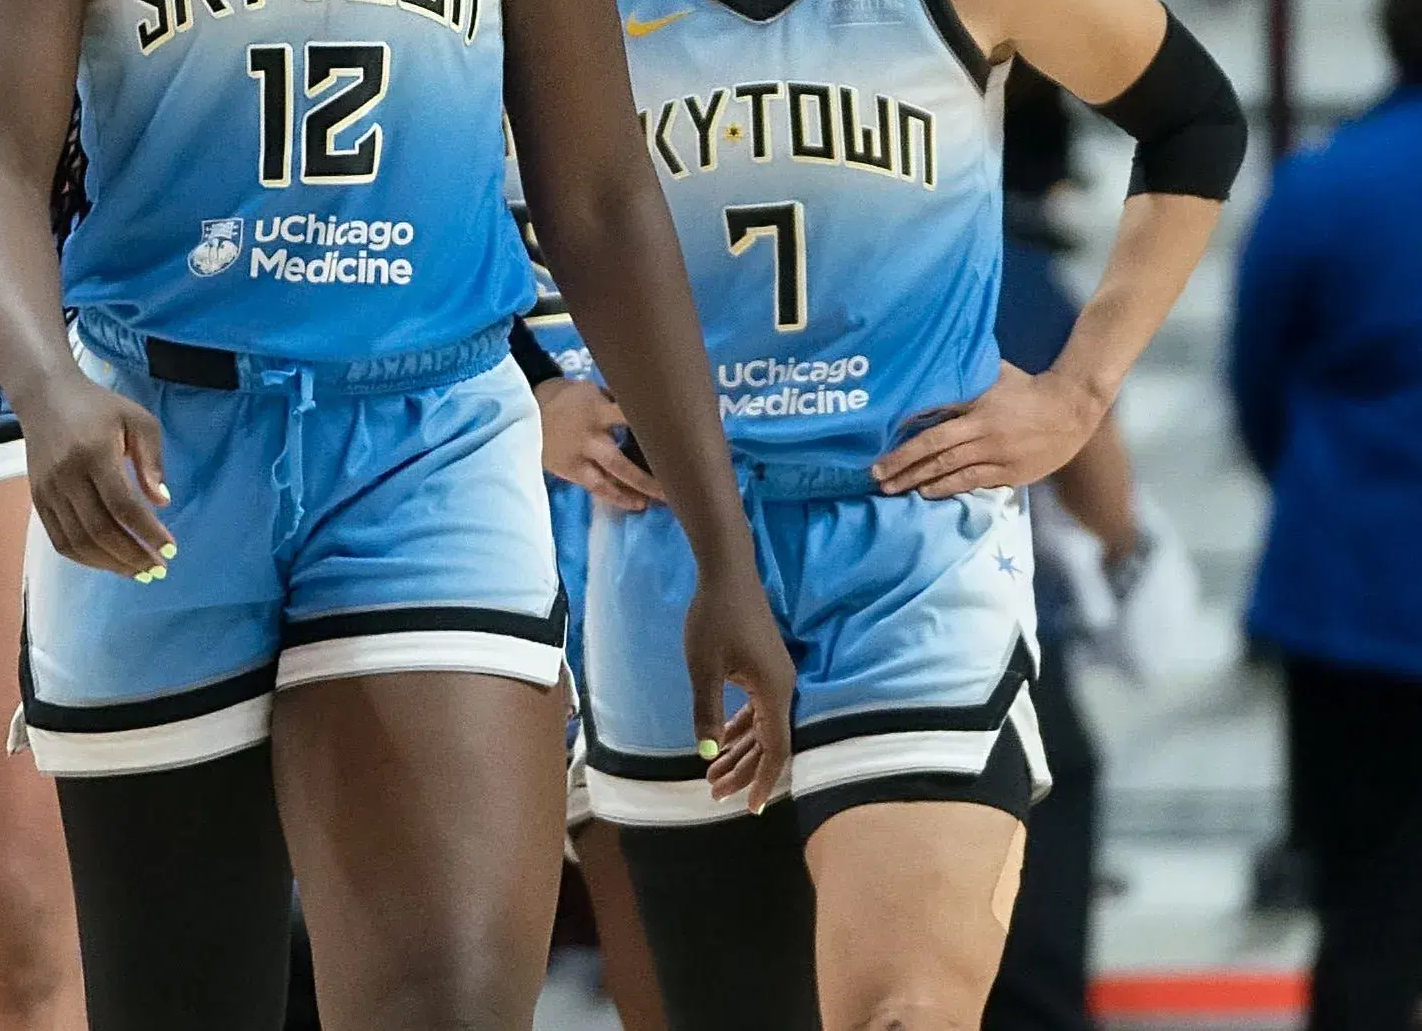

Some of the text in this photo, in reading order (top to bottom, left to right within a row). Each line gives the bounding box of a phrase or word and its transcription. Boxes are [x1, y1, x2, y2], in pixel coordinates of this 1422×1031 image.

[246, 41, 392, 188] 12
[638, 80, 937, 192] KYTOWN
[254, 213, 415, 251] UChicago
[250, 247, 414, 285] Medicine
[725, 200, 808, 331] 7
[718, 354, 870, 389] UChicago
[719, 384, 870, 420] Medicine
